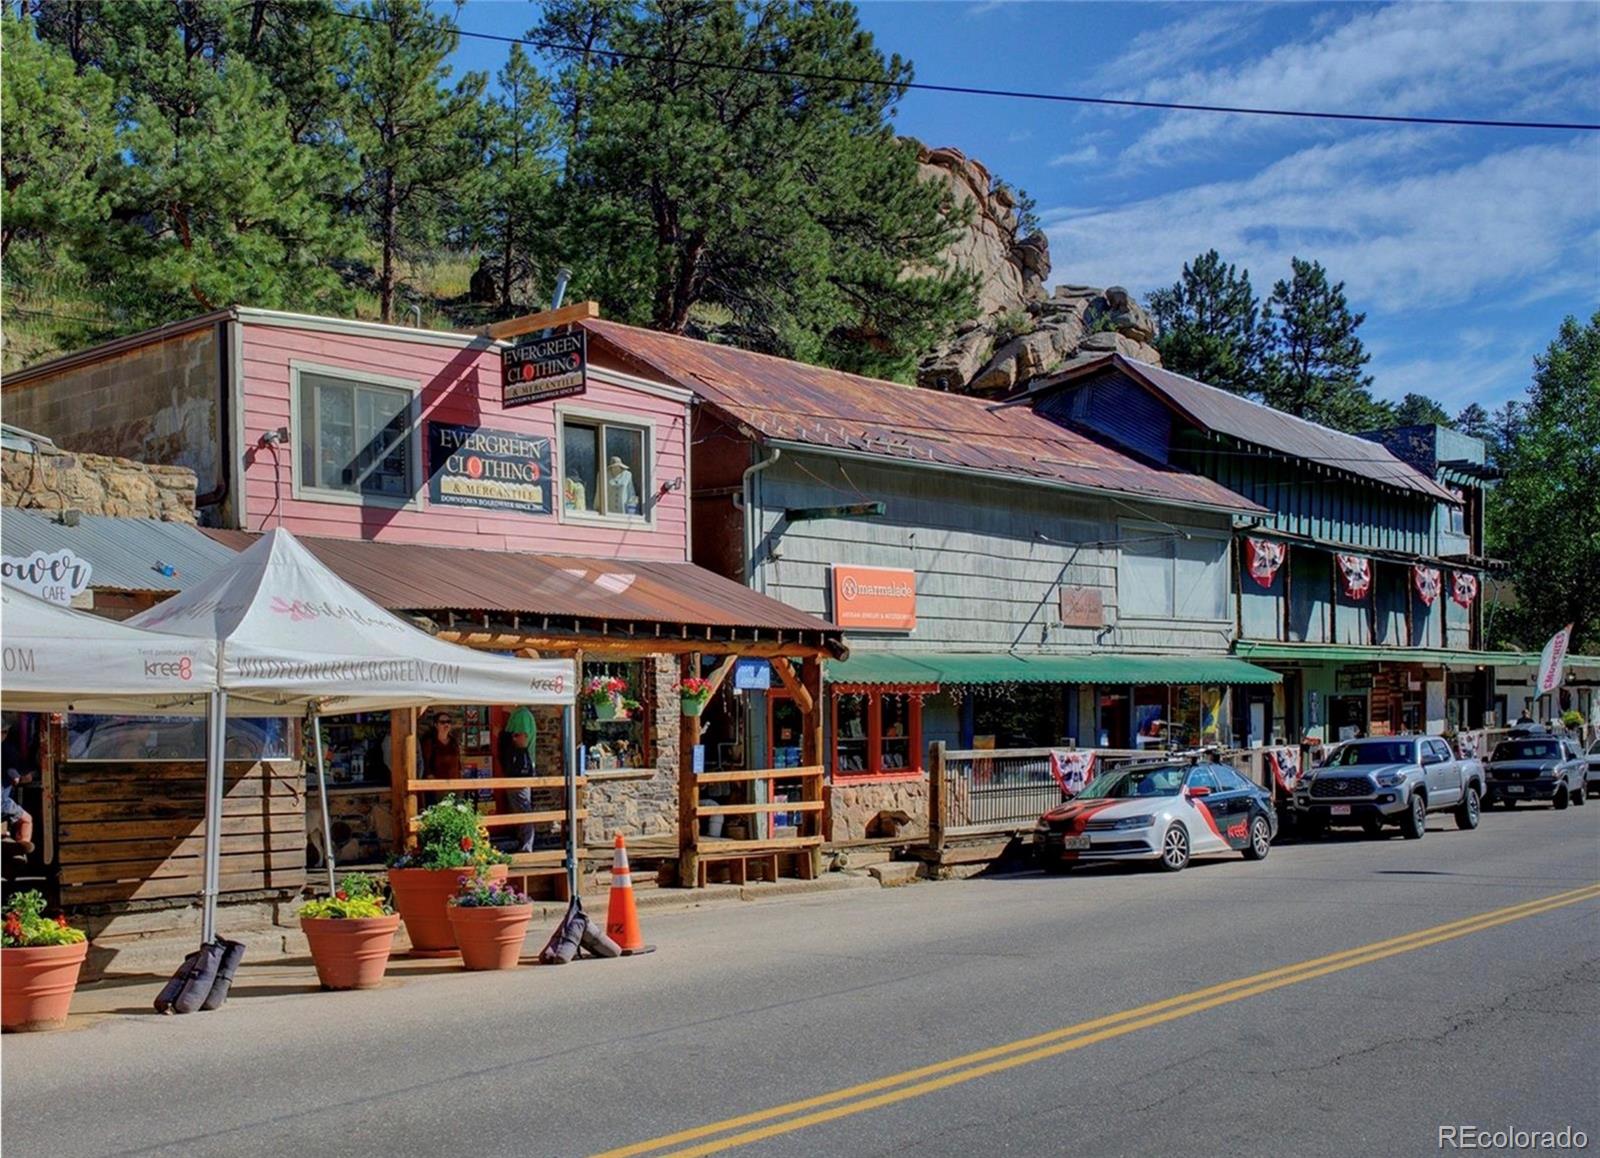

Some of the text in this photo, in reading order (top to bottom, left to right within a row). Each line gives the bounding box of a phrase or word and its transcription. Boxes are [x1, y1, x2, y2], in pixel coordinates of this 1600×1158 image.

[504, 335, 582, 365] EVERGREEN
[507, 352, 580, 382] CLOTHING
[522, 378, 574, 393] MERCANTILE
[440, 429, 541, 458] EVERGREEN
[446, 455, 540, 481] CLOTHING
[453, 483, 535, 500] & MERCANTILE
[42, 585, 66, 601] CAFE
[857, 580, 912, 598] marmalade
[144, 656, 192, 680] kree8
[237, 656, 460, 684] WILDFLOWEREVERGREEN.COM
